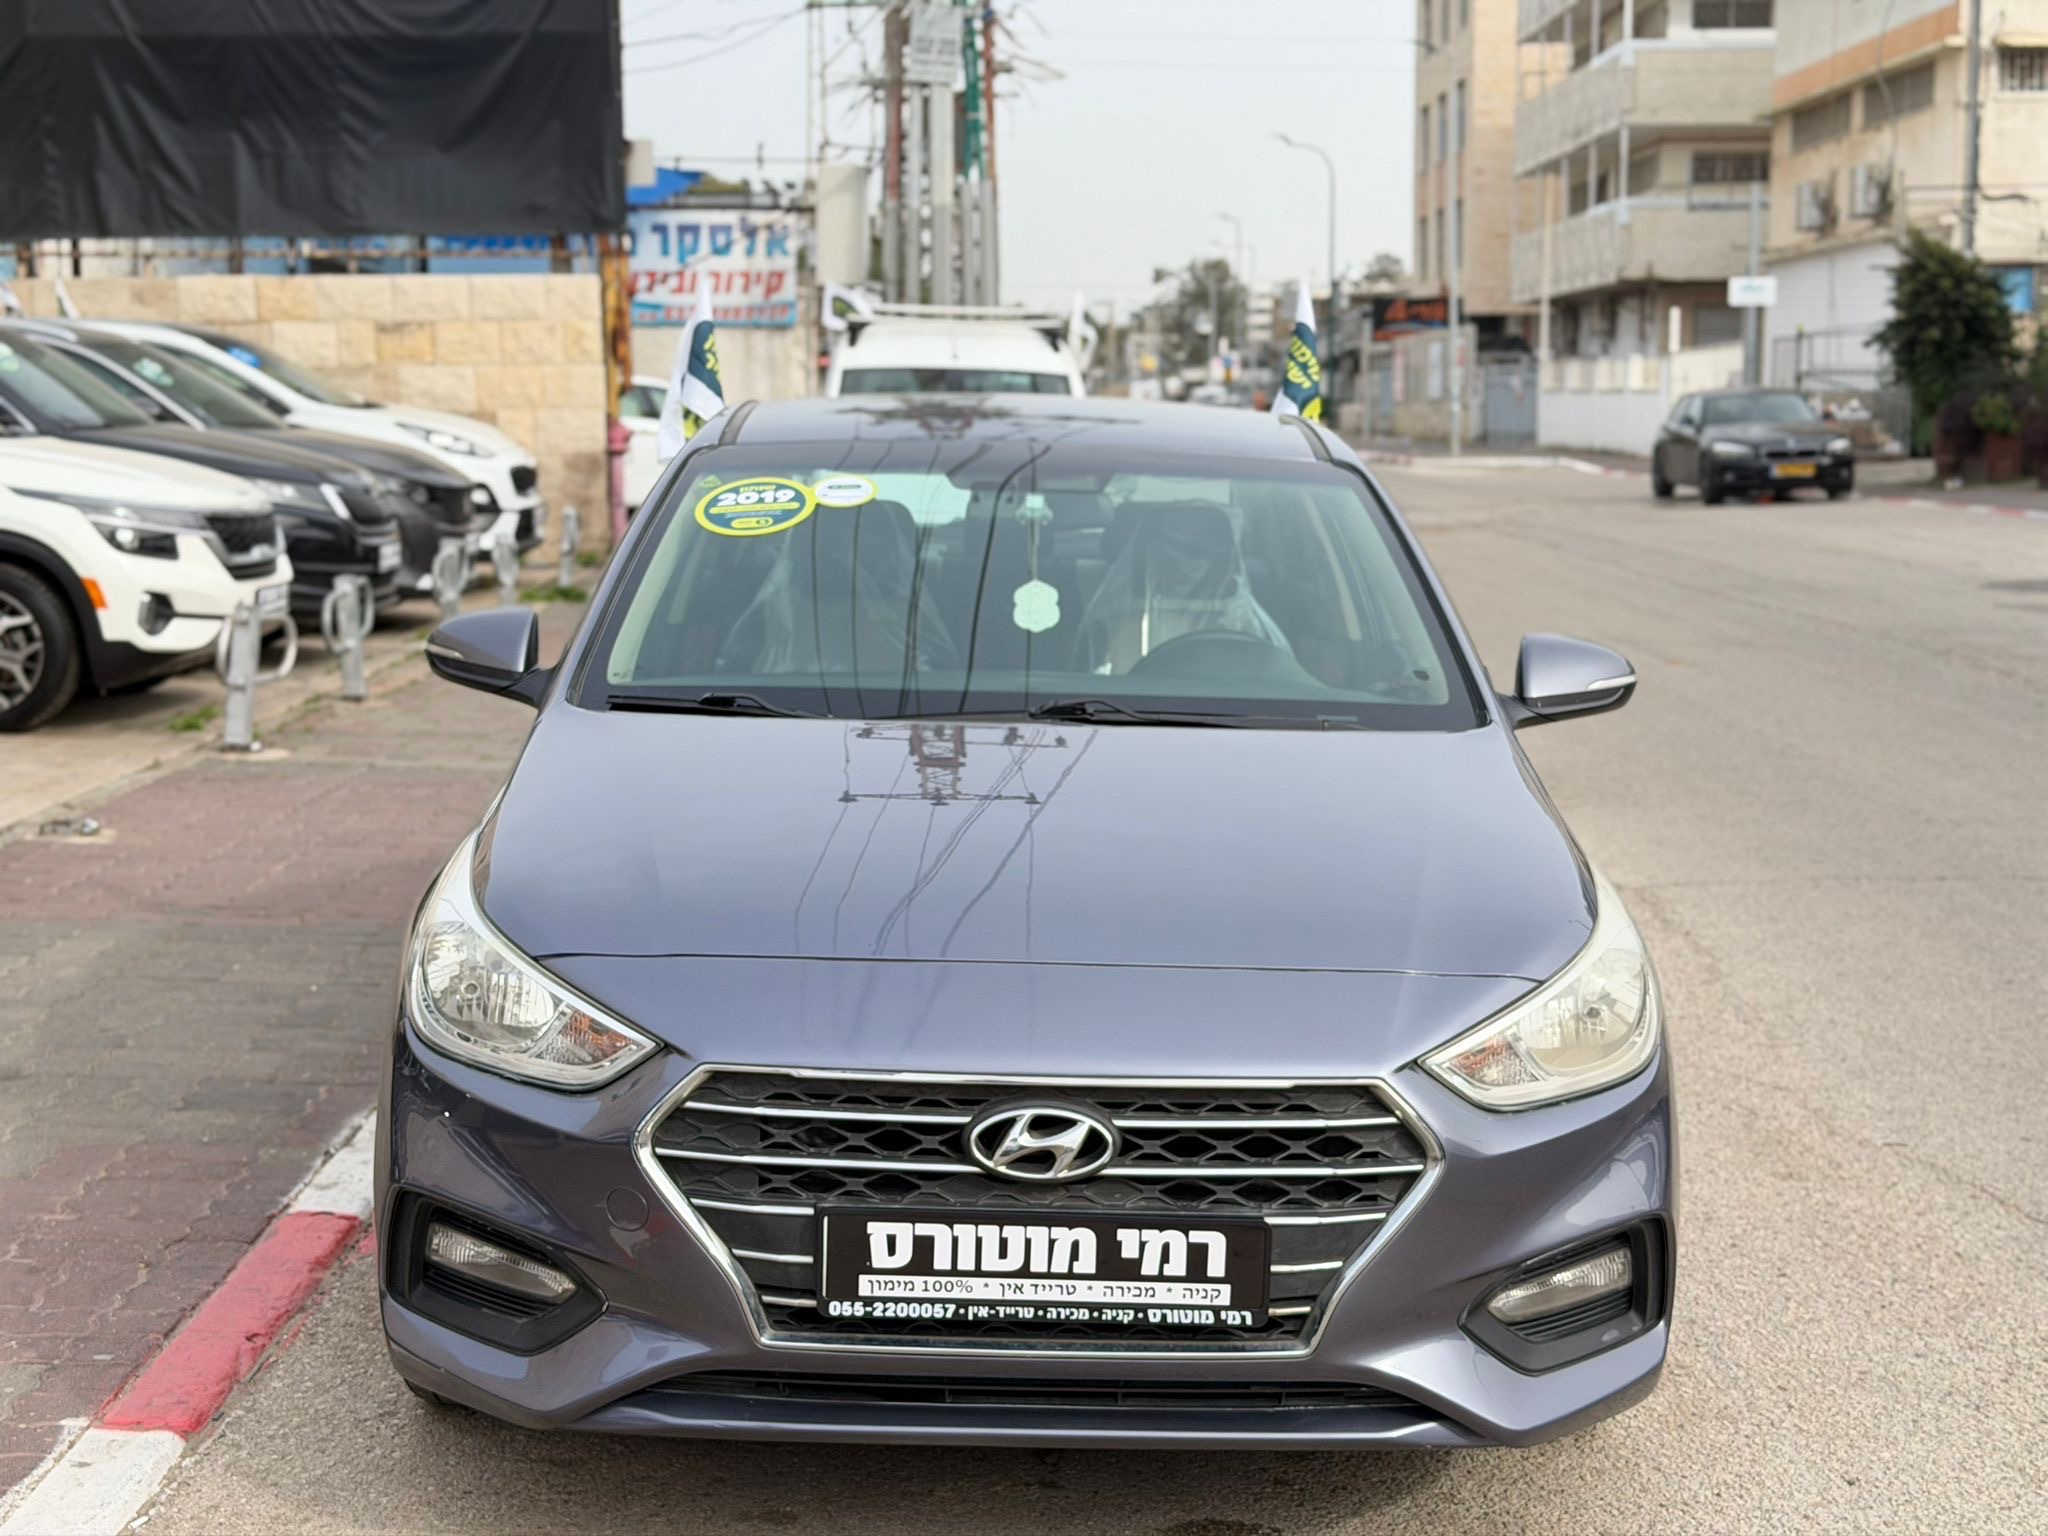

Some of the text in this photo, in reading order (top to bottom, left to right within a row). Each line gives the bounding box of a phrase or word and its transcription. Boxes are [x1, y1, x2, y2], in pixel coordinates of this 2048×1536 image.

[716, 489, 796, 507] 2019
[867, 1221, 1227, 1278] רמי מוטורס
[867, 1278, 1222, 1303] קניה מכירה טרייד אין 100% מימון
[828, 1300, 957, 1318] 055-2200057
[1046, 1306, 1090, 1321] מכירה
[1101, 1307, 1135, 1324] קניה
[1147, 1308, 1215, 1325] מוטורס
[1219, 1310, 1254, 1326] רמי
